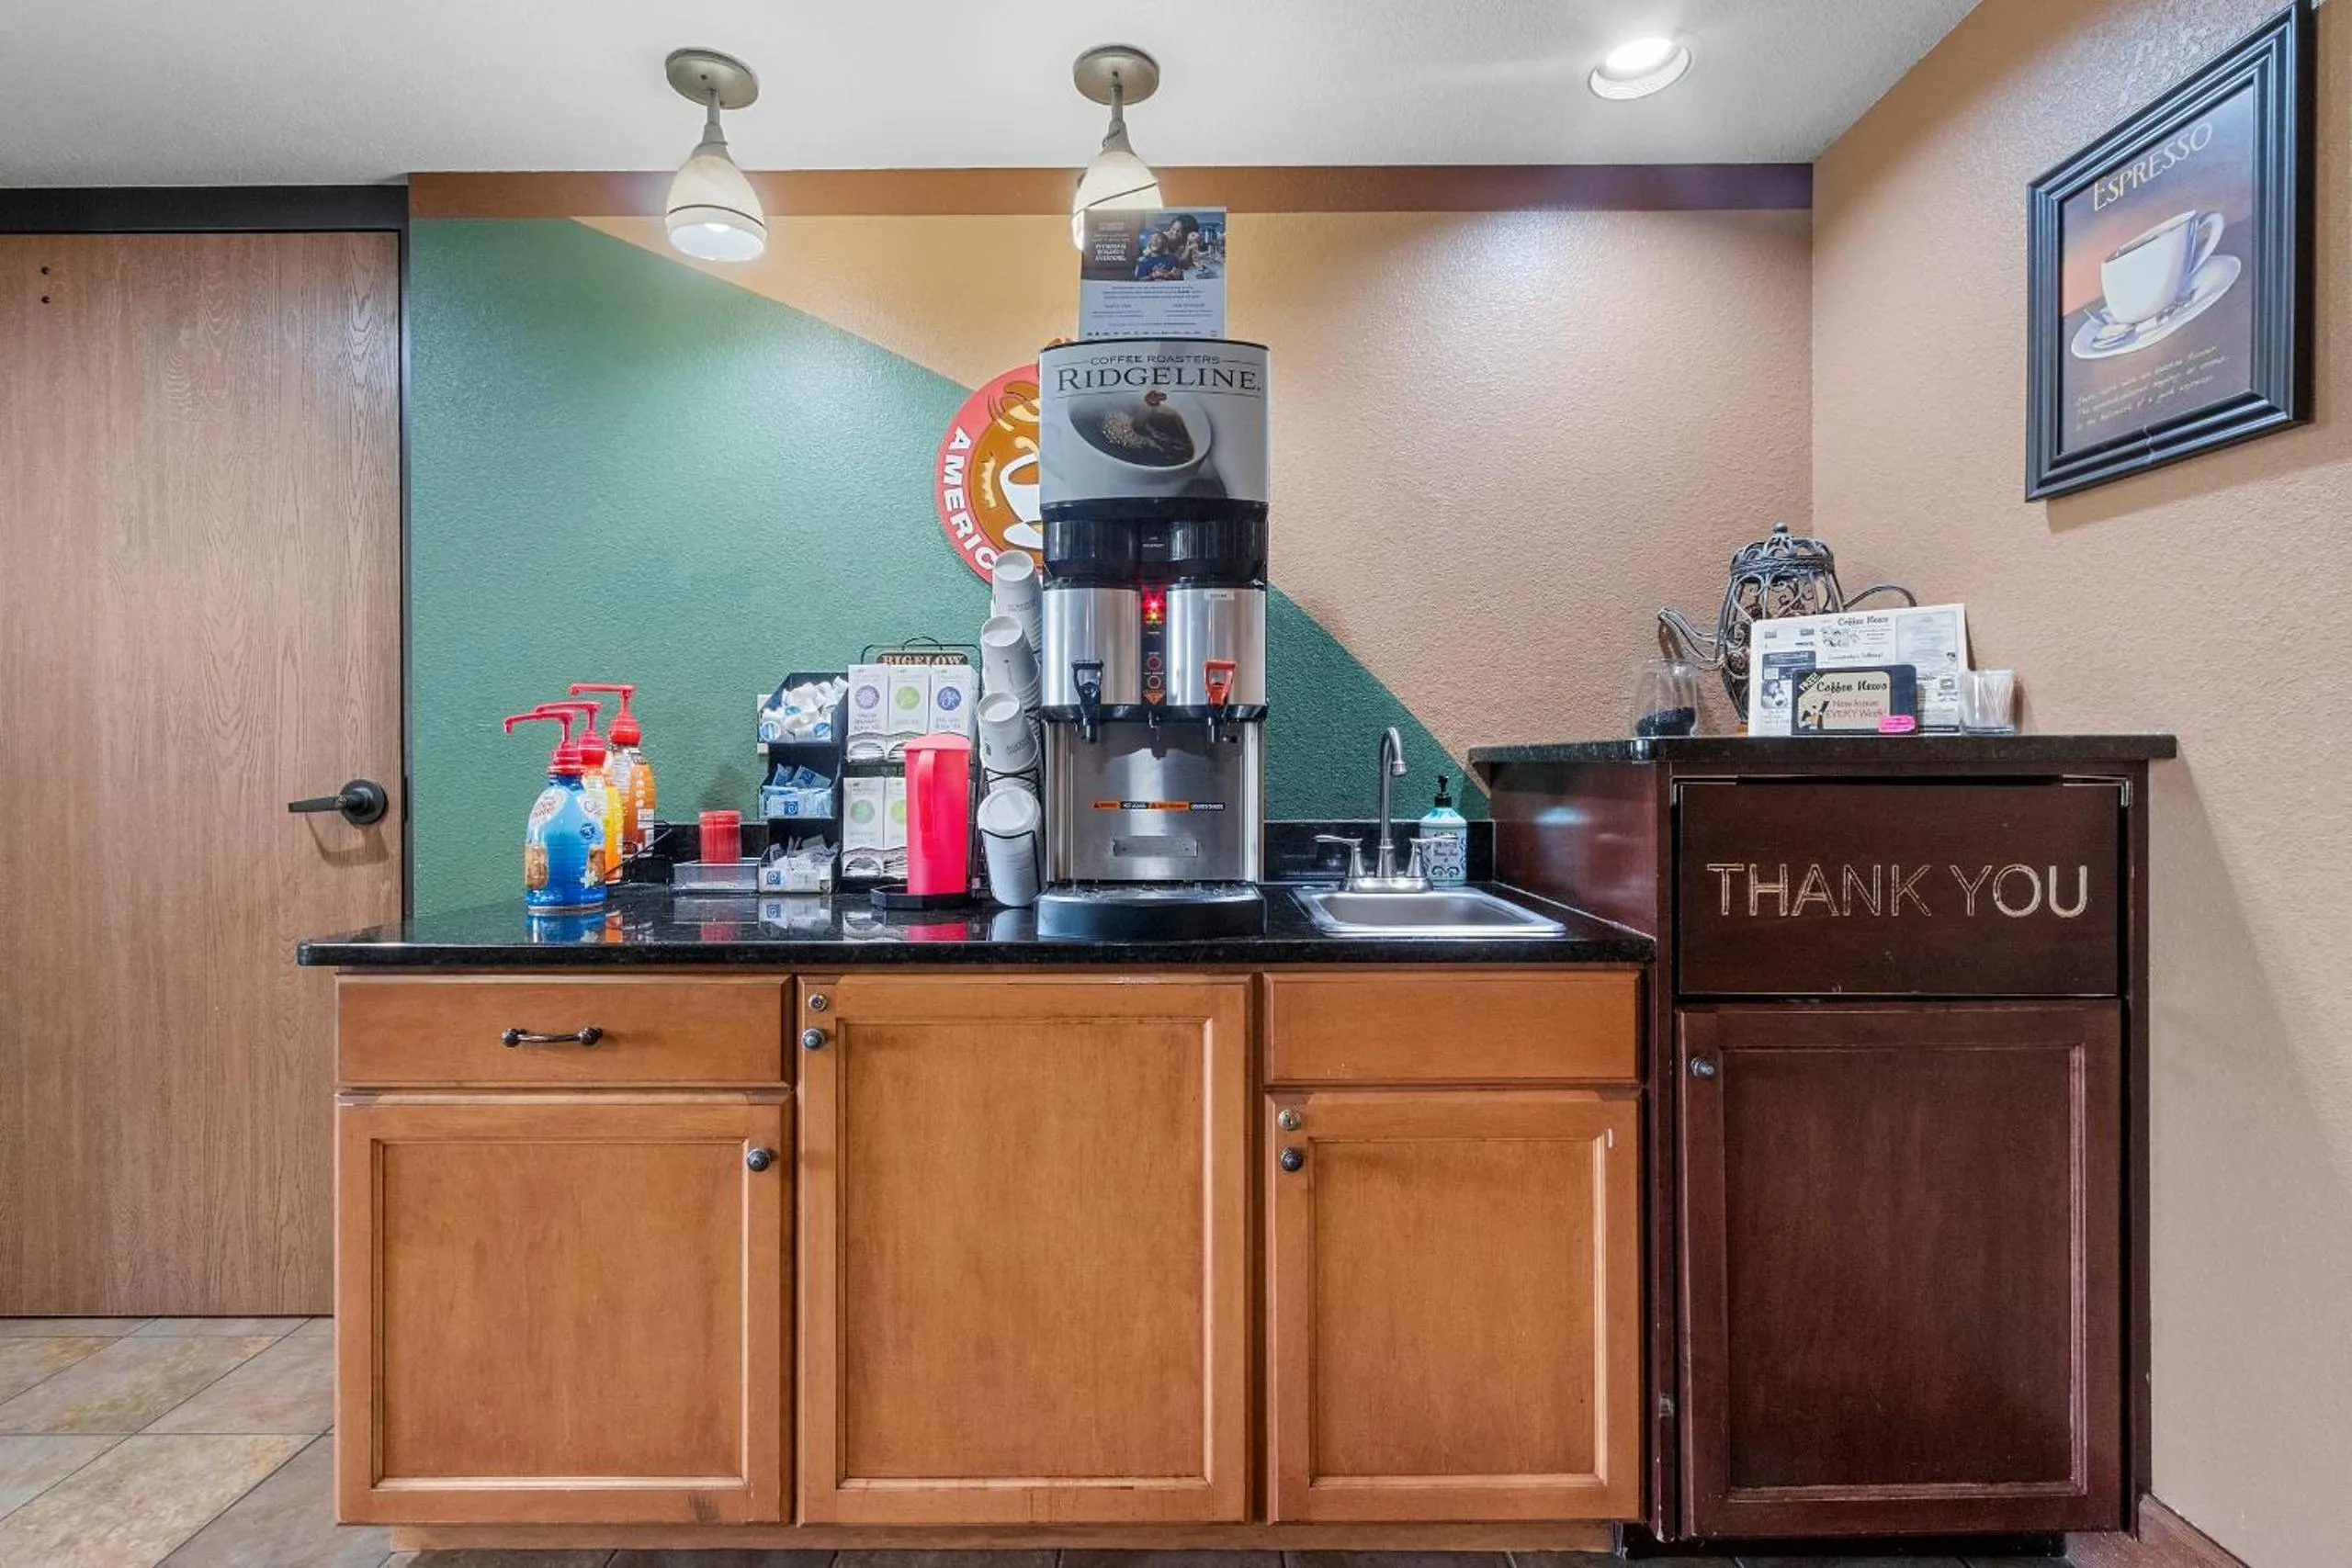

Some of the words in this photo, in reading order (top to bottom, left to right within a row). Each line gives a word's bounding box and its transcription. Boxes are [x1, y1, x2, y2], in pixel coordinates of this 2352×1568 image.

[2095, 122, 2213, 211] ESPRESSO
[1090, 355, 1143, 366] COFFEE
[1147, 354, 1221, 365] ROASTERS
[943, 425, 996, 570] AMERIC
[1815, 682, 1854, 694] Coffee
[1857, 680, 1888, 692] News
[1706, 863, 1931, 917] THANK
[1950, 863, 2088, 918] YOU
